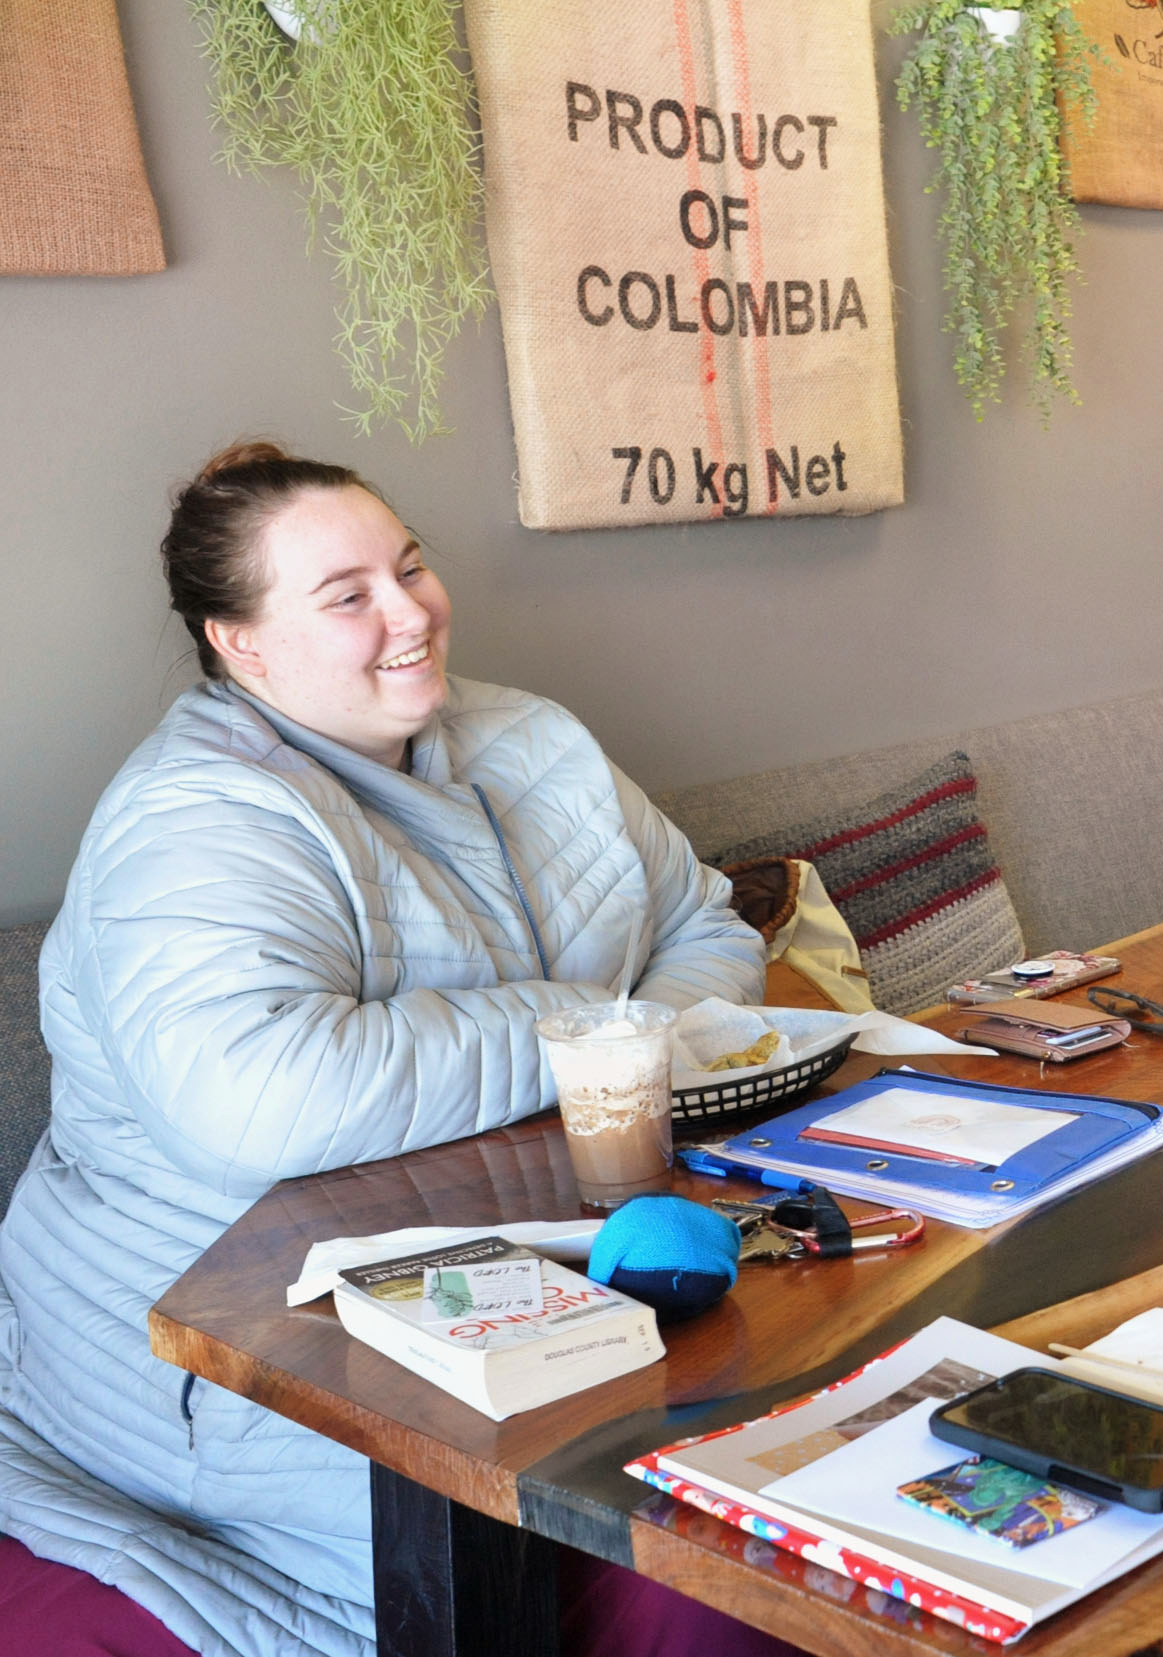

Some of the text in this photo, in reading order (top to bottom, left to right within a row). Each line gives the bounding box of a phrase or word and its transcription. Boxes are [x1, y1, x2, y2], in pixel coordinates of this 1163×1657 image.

[565, 80, 838, 170] PRODUCT
[679, 189, 749, 251] OF
[576, 265, 868, 337] COLOMBIA
[611, 440, 848, 517] 70 kg Net
[364, 1245, 505, 1284] PATRICIA GIBNEY
